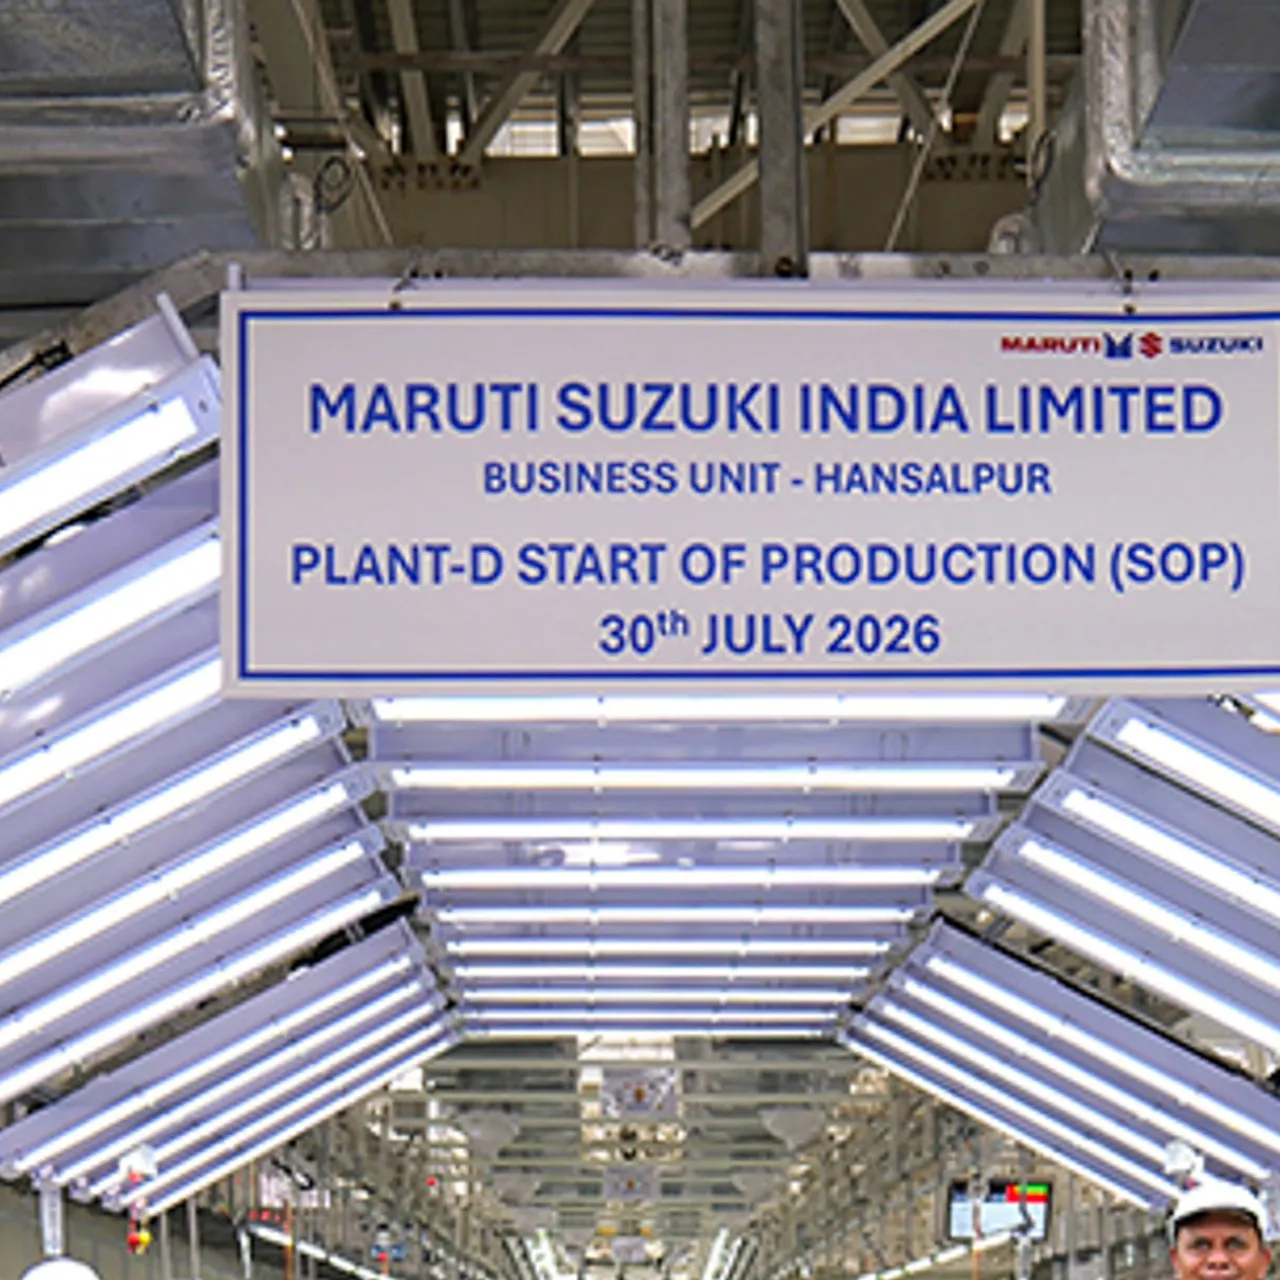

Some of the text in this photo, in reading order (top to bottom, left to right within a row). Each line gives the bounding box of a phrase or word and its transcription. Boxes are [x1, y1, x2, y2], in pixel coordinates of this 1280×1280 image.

[1000, 336, 1263, 354] MARUTI SUZUKI
[310, 383, 1223, 434] MARUTI SUZUKI INDIA LIMITED
[484, 461, 679, 495] BUSINESS
[689, 462, 781, 495] UNIT
[815, 462, 1052, 496] HANSALPUR
[292, 542, 1245, 594] PLANT-D START OF PRODUCTION (SOP)
[600, 610, 941, 656] 30th JULY 2026
